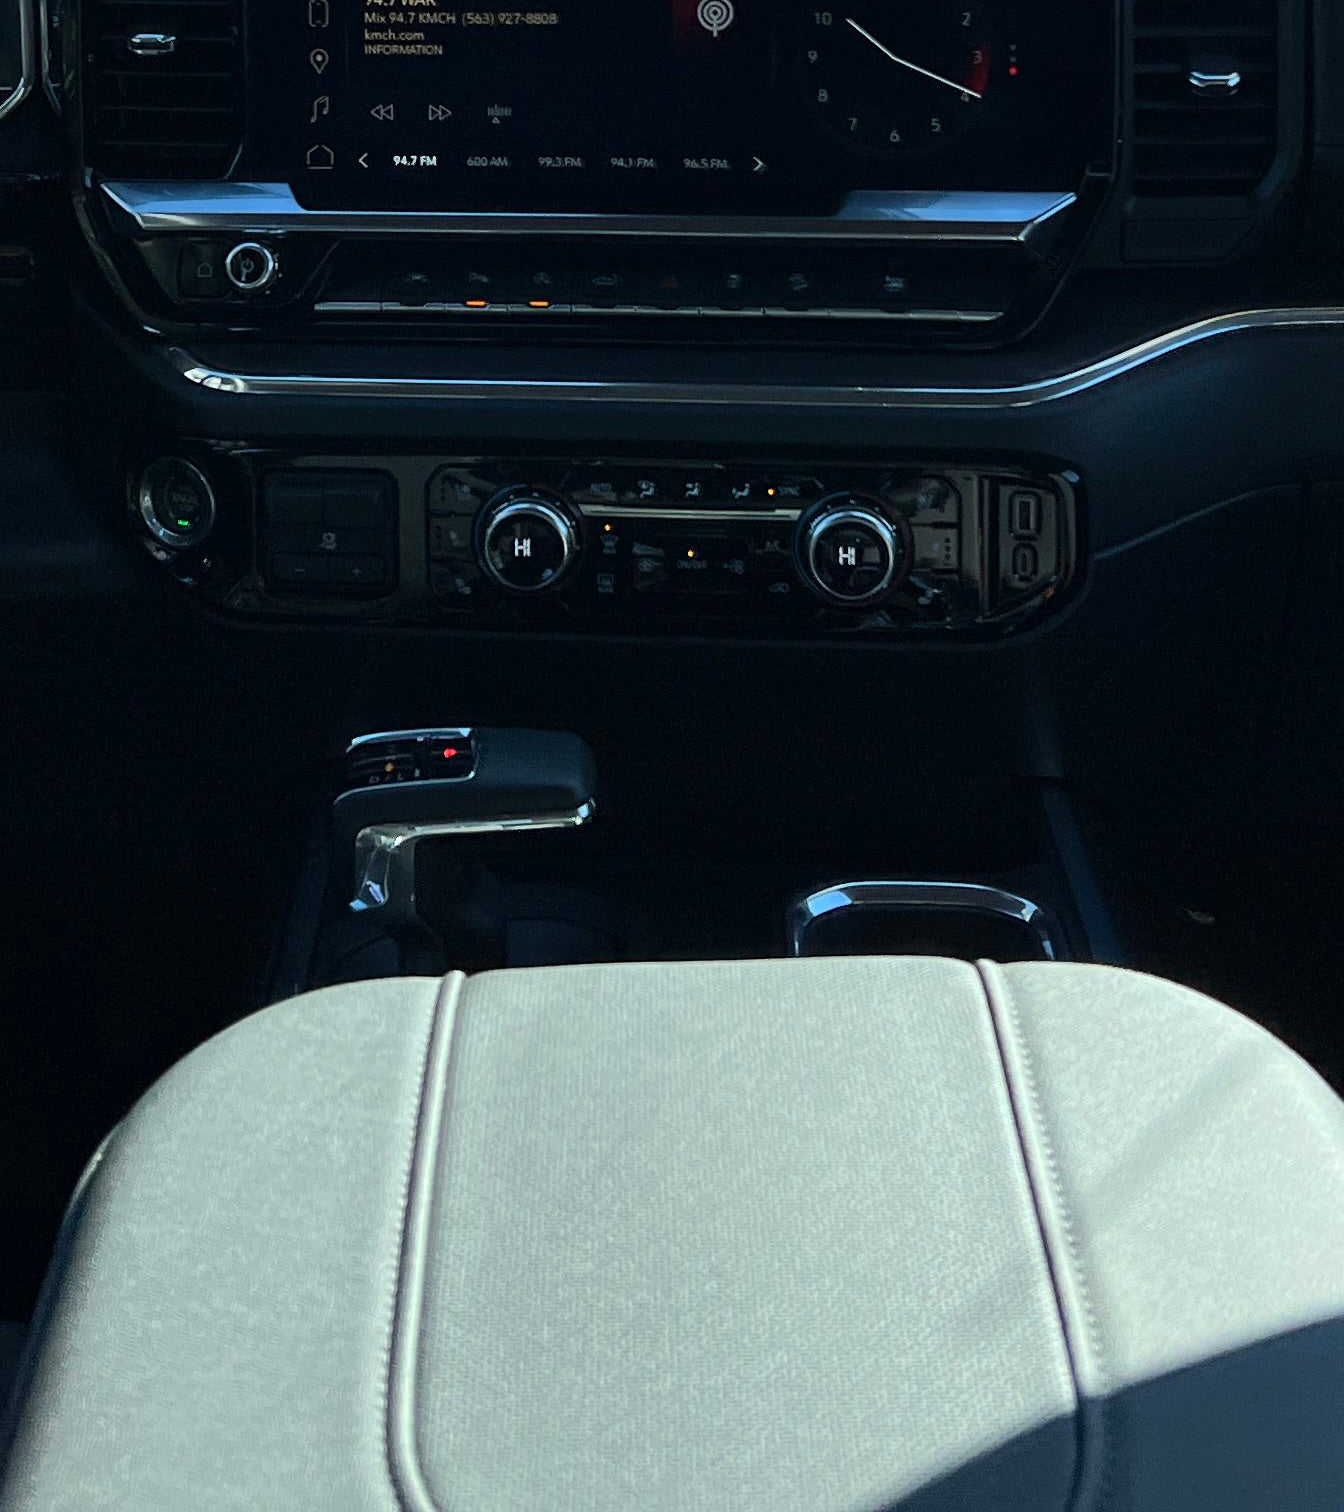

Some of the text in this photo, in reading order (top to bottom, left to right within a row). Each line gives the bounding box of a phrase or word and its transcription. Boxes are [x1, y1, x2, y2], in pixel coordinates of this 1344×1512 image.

[363, 13, 386, 24] Mix
[388, 13, 415, 24] 94.7
[418, 13, 456, 25] KMCH
[814, 12, 832, 26] 10
[960, 12, 971, 26] 2
[364, 29, 424, 41] kmch.com
[364, 44, 443, 56] INFORMATION
[807, 50, 818, 64] 9
[972, 50, 982, 64] 3
[818, 88, 829, 103] 8
[848, 117, 858, 131] 7
[931, 118, 941, 132] 5
[890, 129, 900, 143] 6
[392, 155, 438, 167] 94.7 FM
[489, 156, 509, 168] AM
[564, 156, 583, 168] FM
[514, 538, 531, 557] HI
[838, 546, 856, 566] HI
